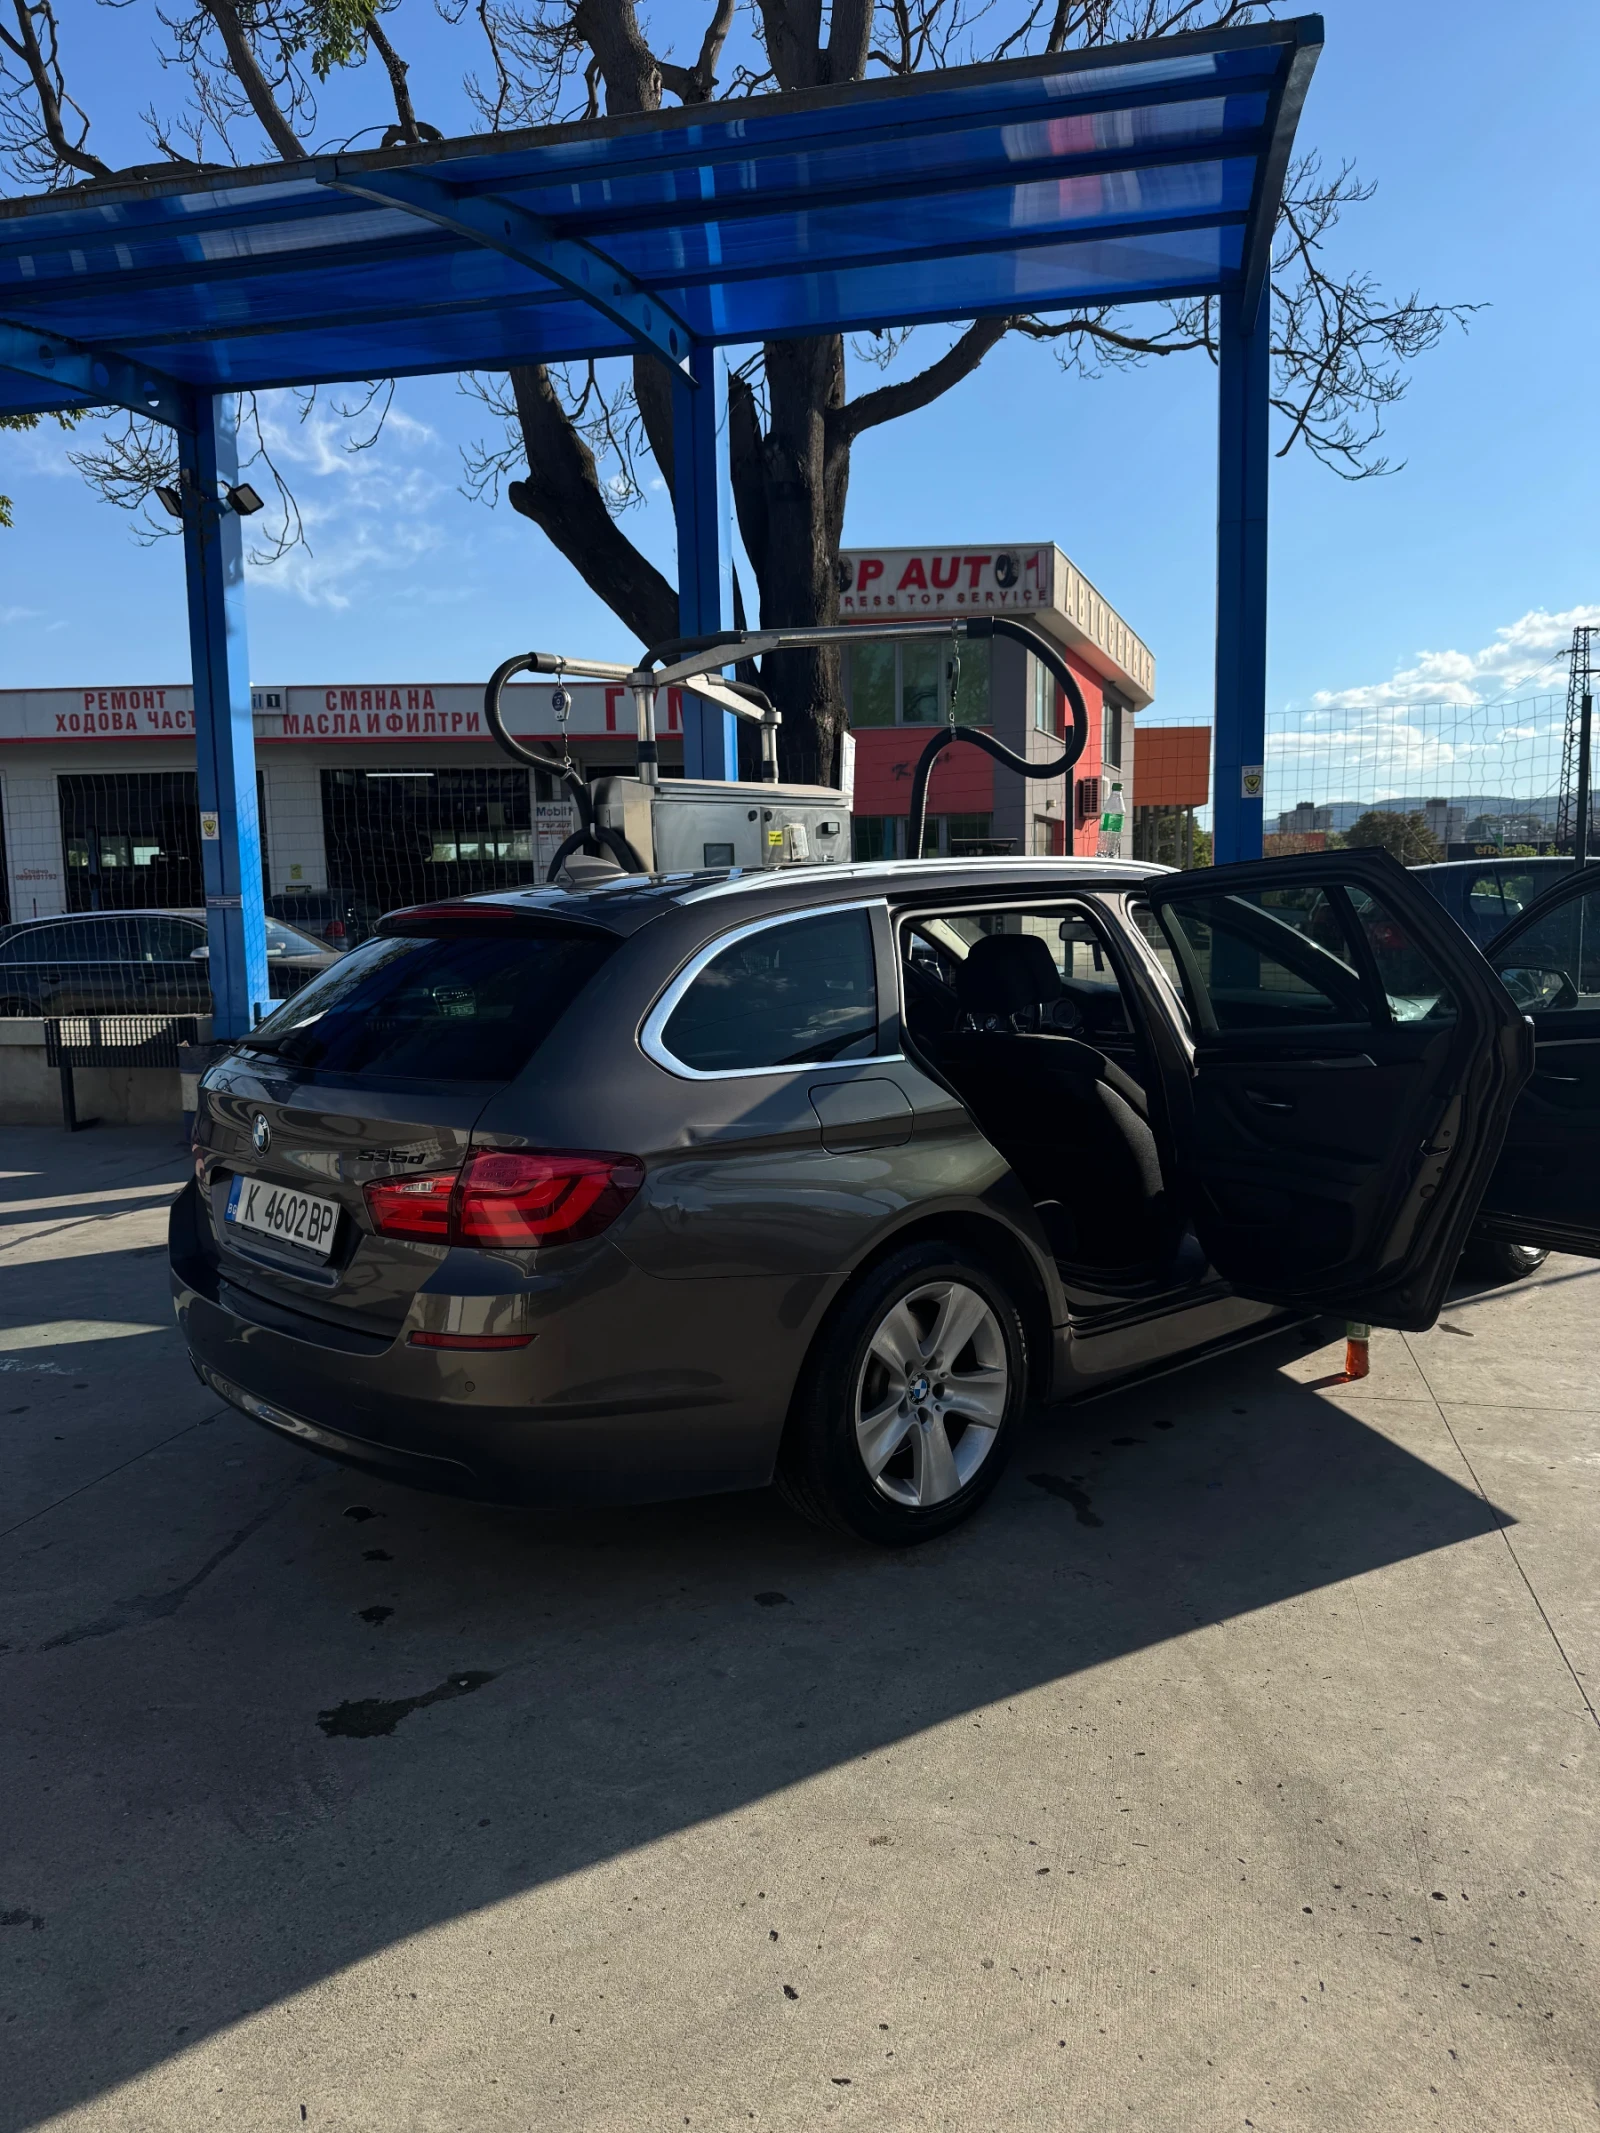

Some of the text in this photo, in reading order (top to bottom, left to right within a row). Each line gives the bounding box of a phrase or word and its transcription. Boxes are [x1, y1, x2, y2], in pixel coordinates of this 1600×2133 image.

[839, 555, 884, 593] OP
[844, 590, 1048, 607] RESS TOP SERVICE
[1065, 566, 1152, 691] АВТОСЕРВИЗ
[84, 691, 166, 711] РЕМОНТ
[325, 690, 436, 711] СМЯНА НА
[55, 712, 138, 733] ХОДОВА
[283, 713, 362, 734] МАСЛА
[385, 712, 480, 733] ФИЛТРИ
[536, 807, 567, 816] Mobil
[357, 1149, 426, 1164] 535d
[227, 1203, 238, 1215] BG
[245, 1184, 261, 1222] K
